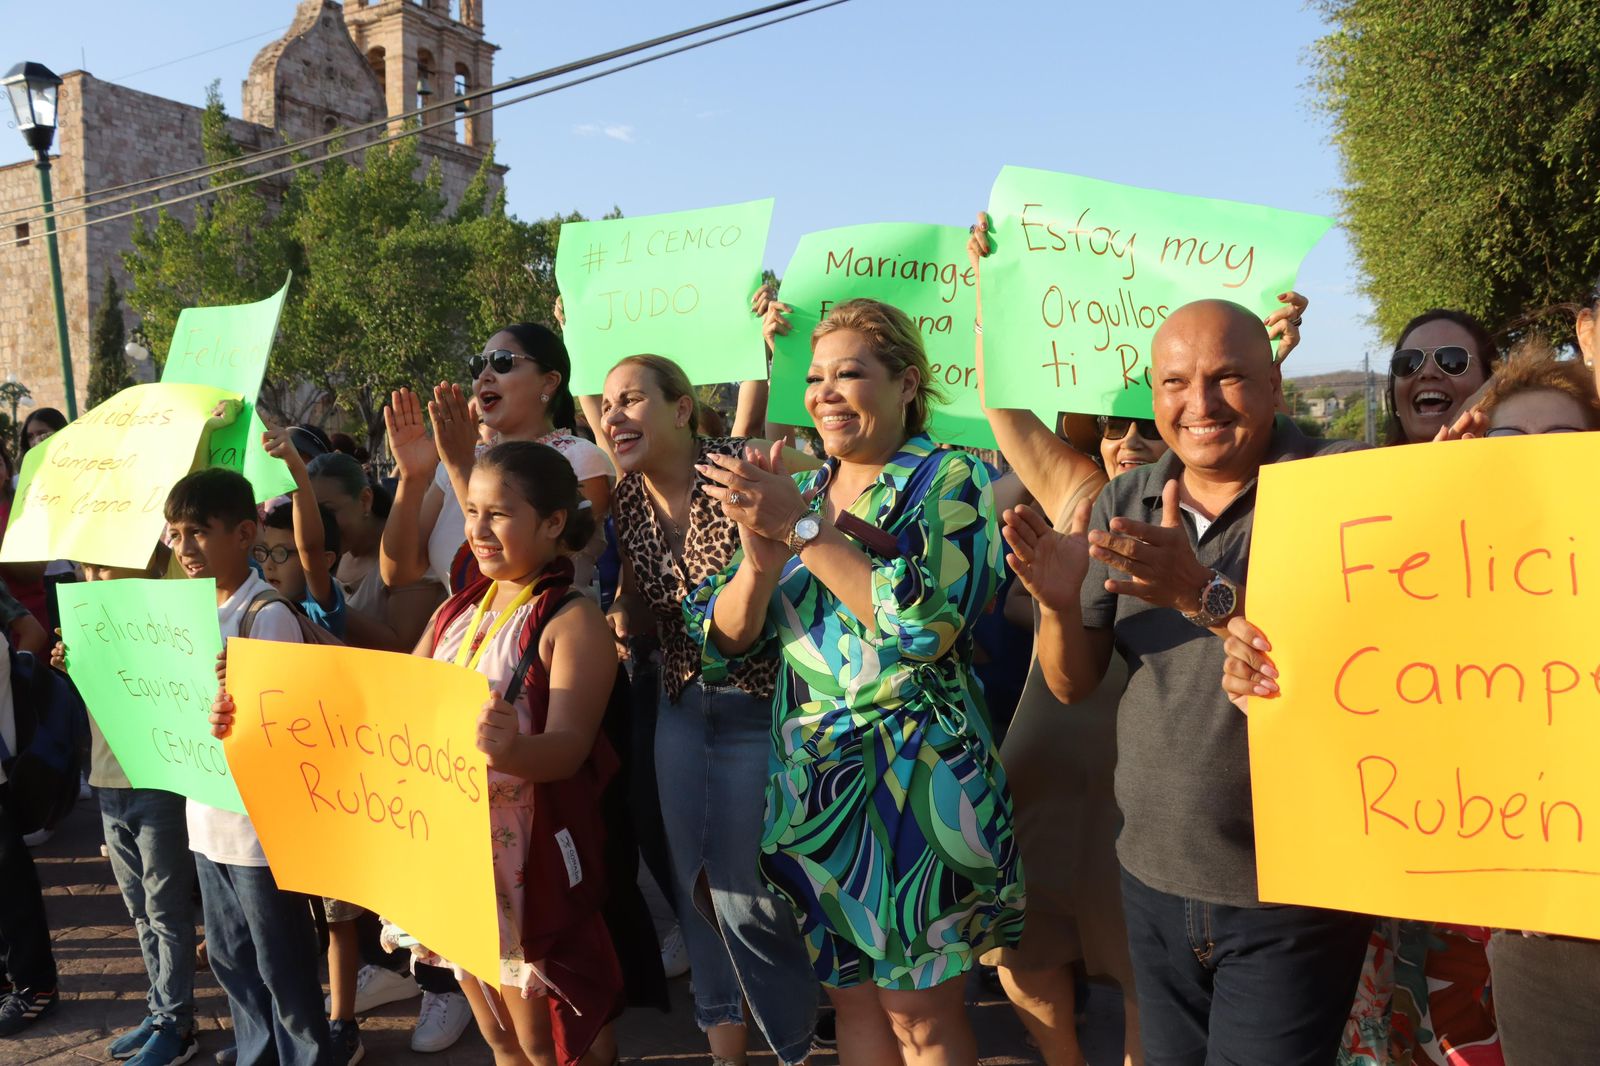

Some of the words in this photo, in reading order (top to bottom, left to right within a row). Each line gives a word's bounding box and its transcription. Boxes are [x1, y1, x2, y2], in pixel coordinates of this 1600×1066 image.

[646, 224, 743, 257] CEMCO
[1020, 203, 1137, 280] Estoy
[1160, 235, 1256, 289] muy
[595, 283, 700, 331] JUDO
[1041, 340, 1077, 388] ti
[1338, 514, 1579, 604] Felici
[73, 602, 194, 656] Felicidades
[116, 668, 190, 714] Equipo
[152, 727, 227, 777] CEMCO
[258, 689, 481, 803] Felicidades
[299, 761, 430, 842] Rubén
[1356, 754, 1584, 844] Rubén
